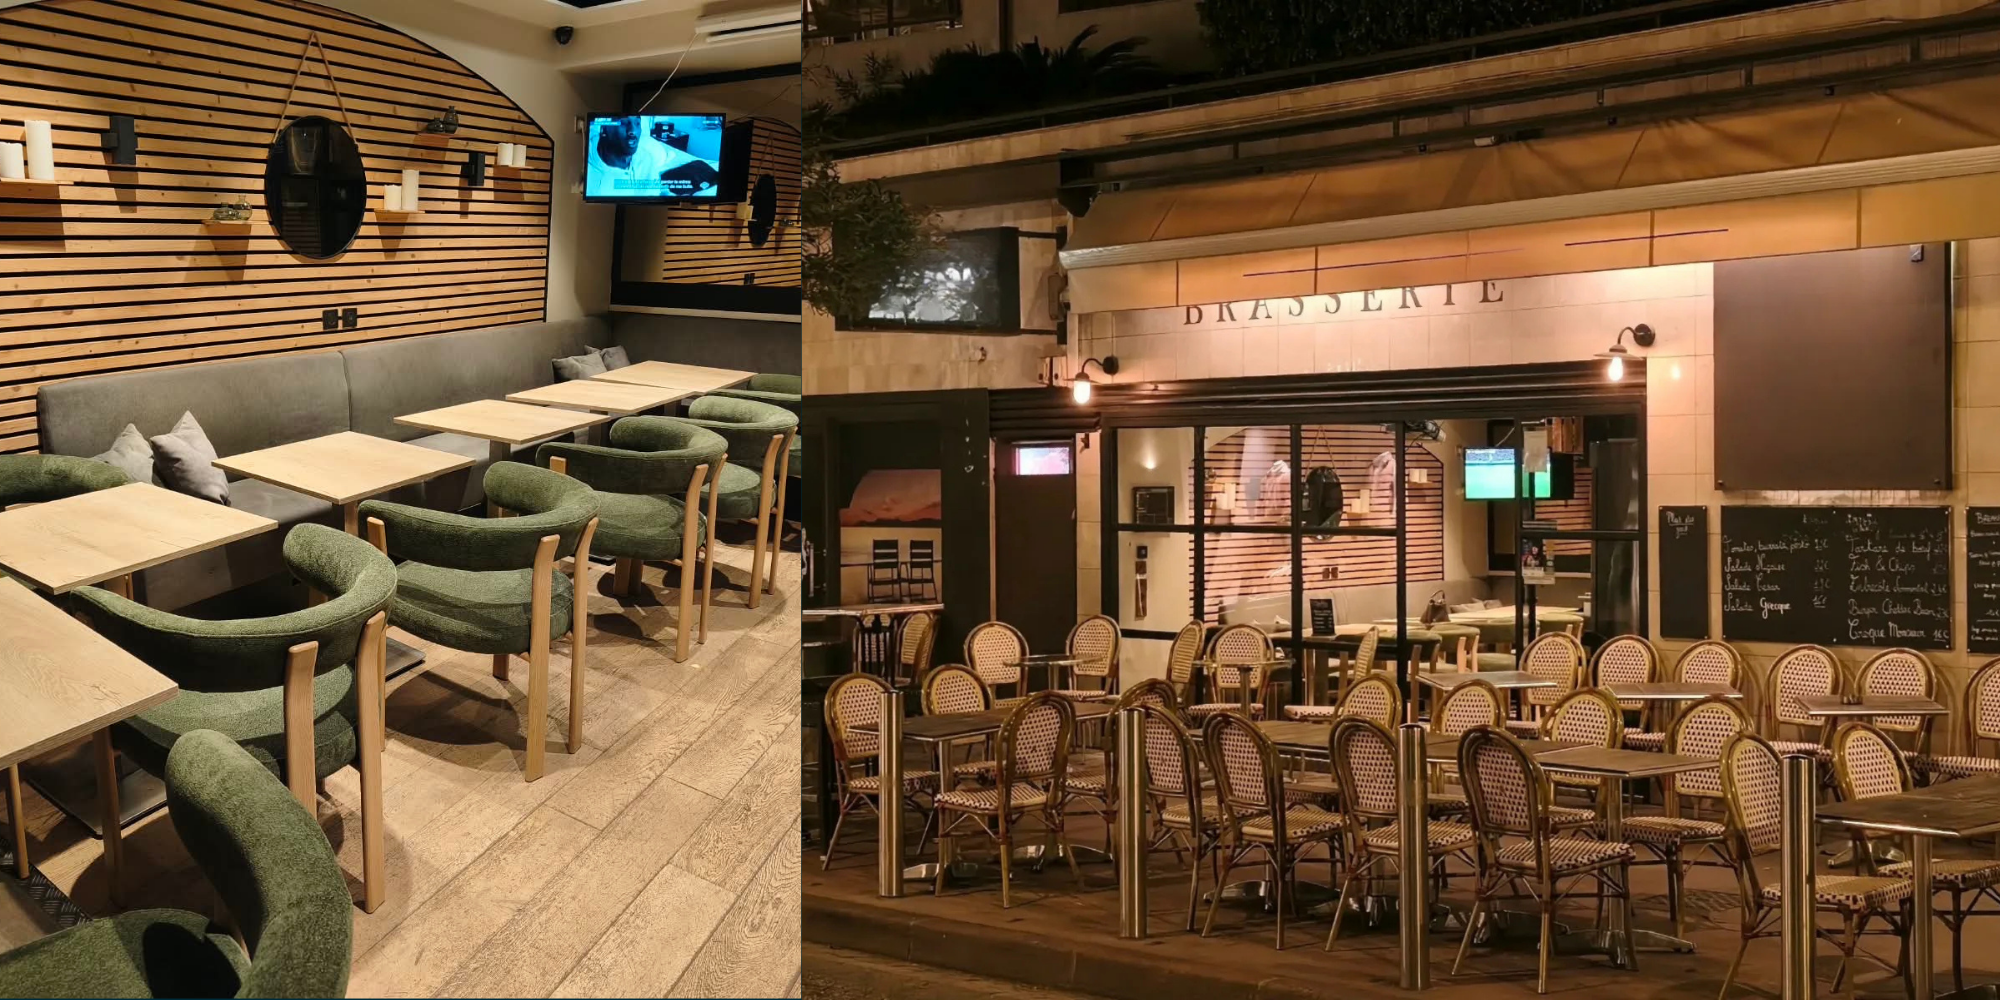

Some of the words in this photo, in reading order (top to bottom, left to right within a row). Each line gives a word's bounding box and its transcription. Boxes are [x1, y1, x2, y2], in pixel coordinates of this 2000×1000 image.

[1183, 280, 1504, 325] BRASSERIE
[1724, 556, 1752, 573] Salade
[1875, 555, 1886, 571] &
[1724, 574, 1751, 591] Salade
[1724, 592, 1753, 611] Salade
[1848, 618, 1886, 644] Croque
